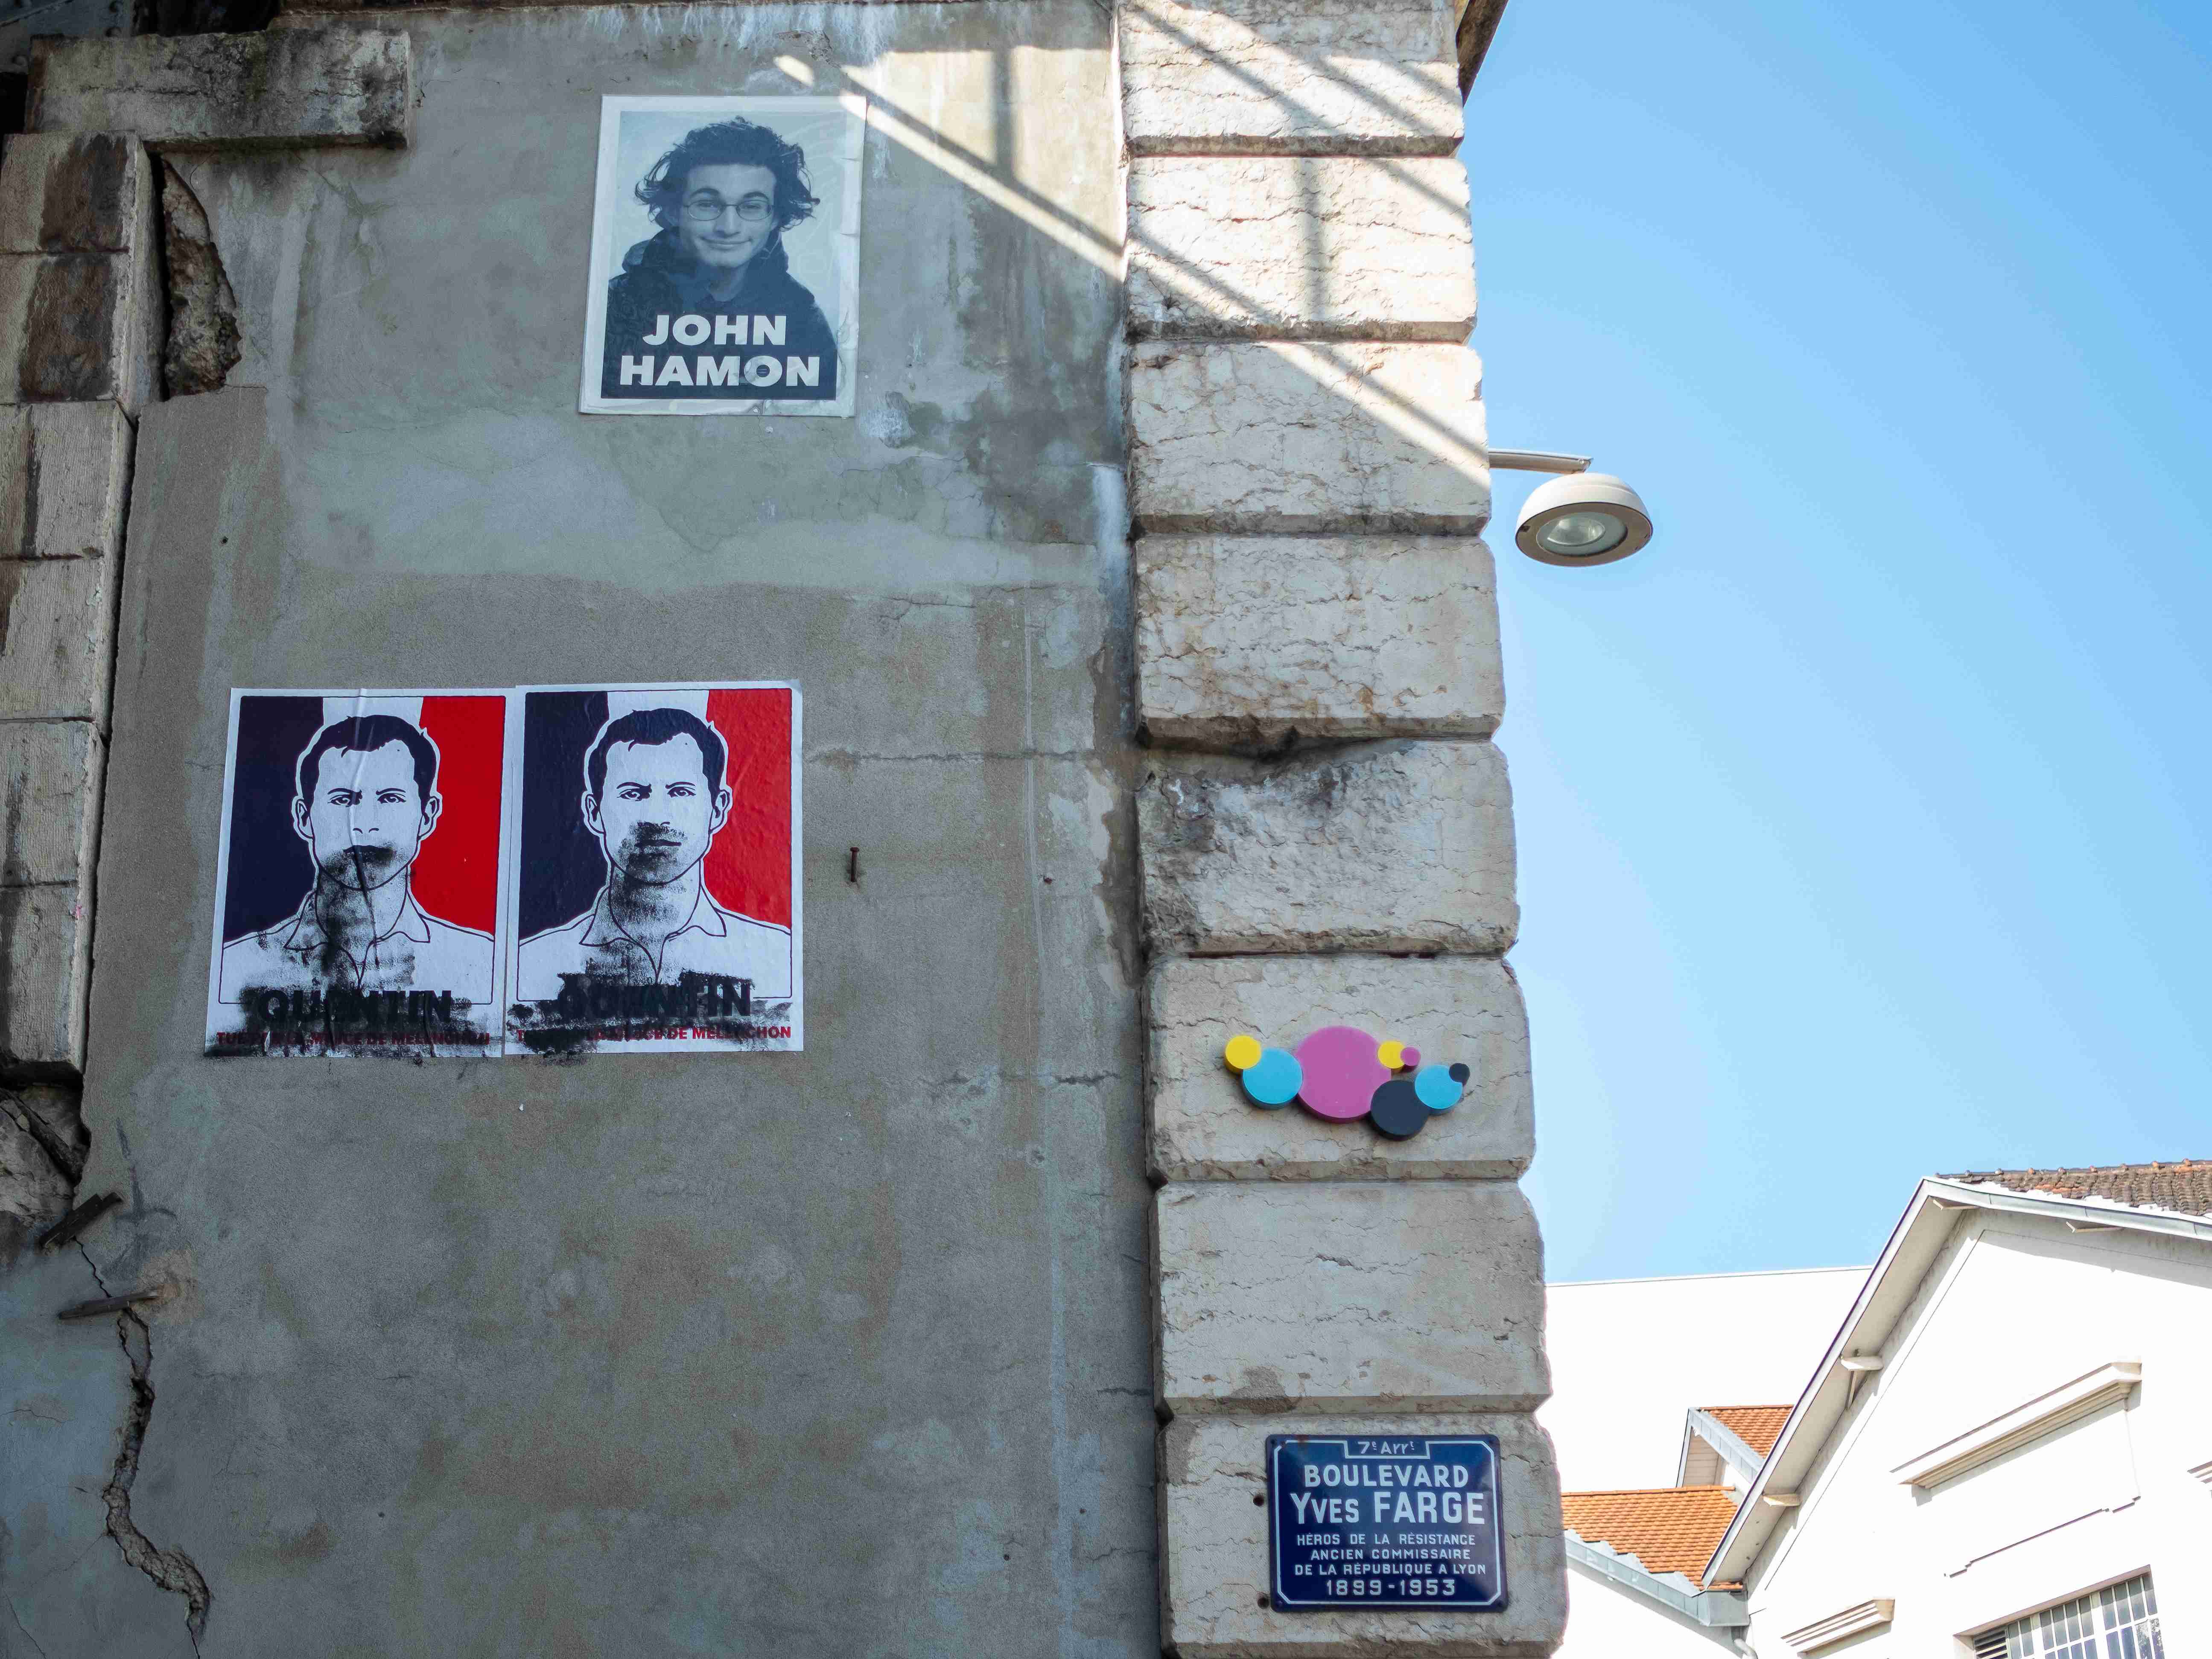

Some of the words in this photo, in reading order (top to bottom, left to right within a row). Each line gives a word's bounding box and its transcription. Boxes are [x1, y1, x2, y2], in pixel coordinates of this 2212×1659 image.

[642, 314, 787, 346] JOHN
[619, 355, 820, 387] HAMON
[669, 1026, 687, 1040] DE
[692, 1026, 791, 1039] MELCHON
[1303, 1464, 1469, 1488] BOULEVARD
[1290, 1492, 1360, 1525] YVES
[1373, 1492, 1485, 1525] FARGE
[1350, 1534, 1366, 1545] DE
[1374, 1534, 1390, 1545] LA
[1310, 1549, 1363, 1561] ANCIEN
[1372, 1548, 1471, 1560] COMMISSAIRE
[1295, 1564, 1313, 1576] DE
[1319, 1564, 1337, 1575] LA
[1438, 1564, 1448, 1574] A
[1453, 1564, 1486, 1575] LYON
